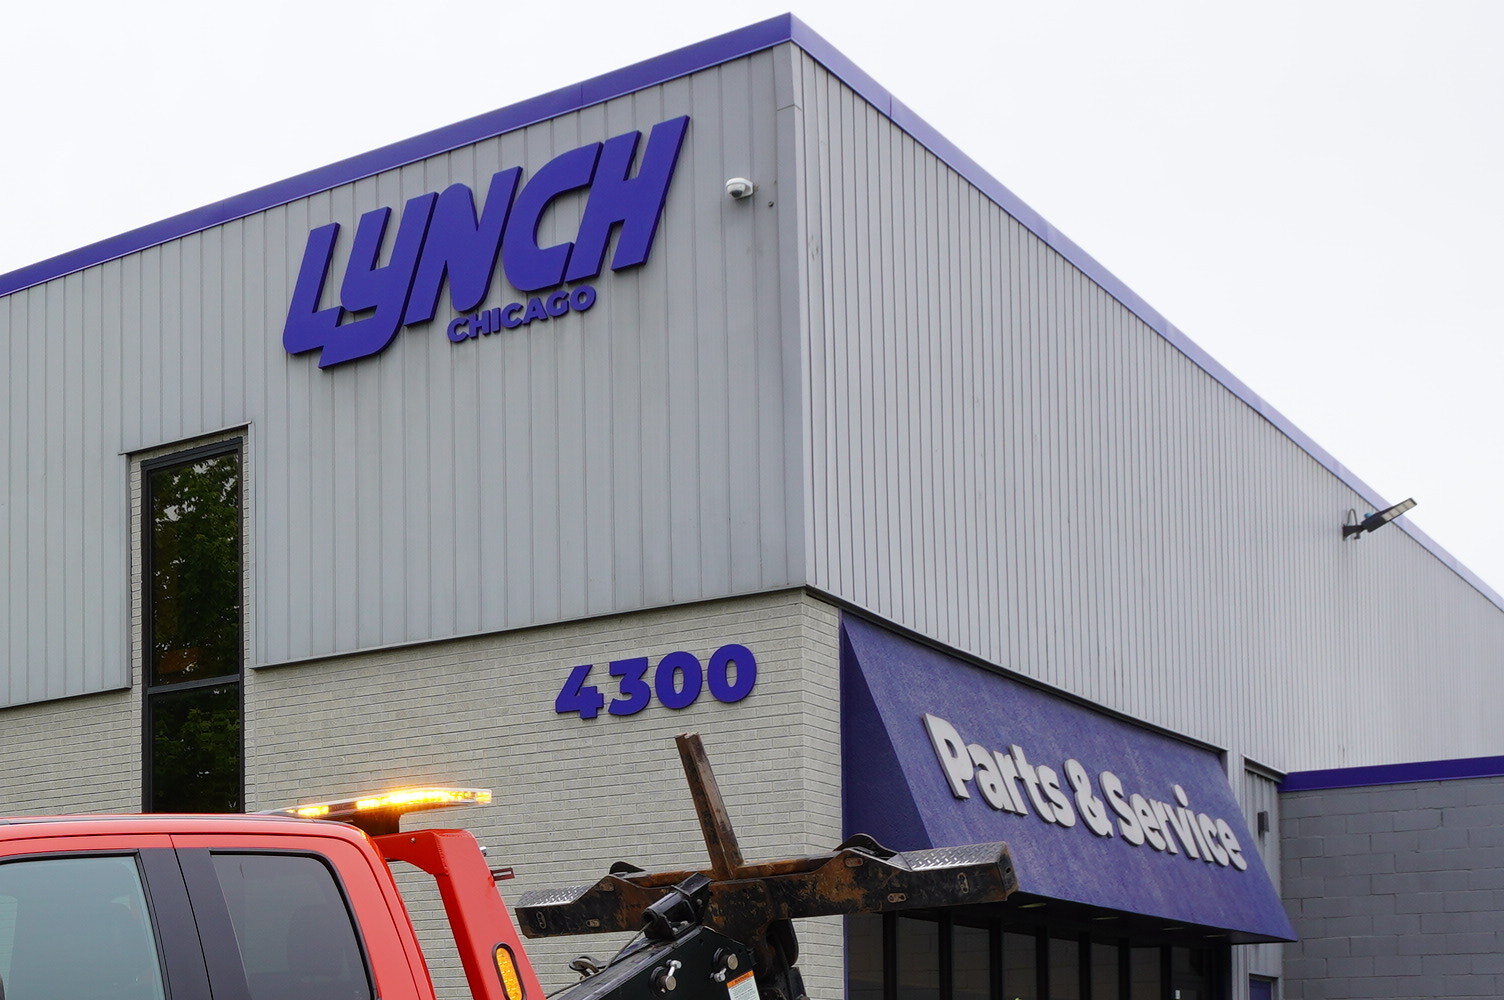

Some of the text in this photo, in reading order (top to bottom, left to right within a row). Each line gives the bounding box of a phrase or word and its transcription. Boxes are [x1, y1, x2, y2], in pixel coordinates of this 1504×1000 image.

[283, 115, 690, 369] LYNCH
[447, 285, 597, 343] CHICAGO
[555, 643, 757, 719] 4300
[923, 713, 1247, 871] Parts & Service
